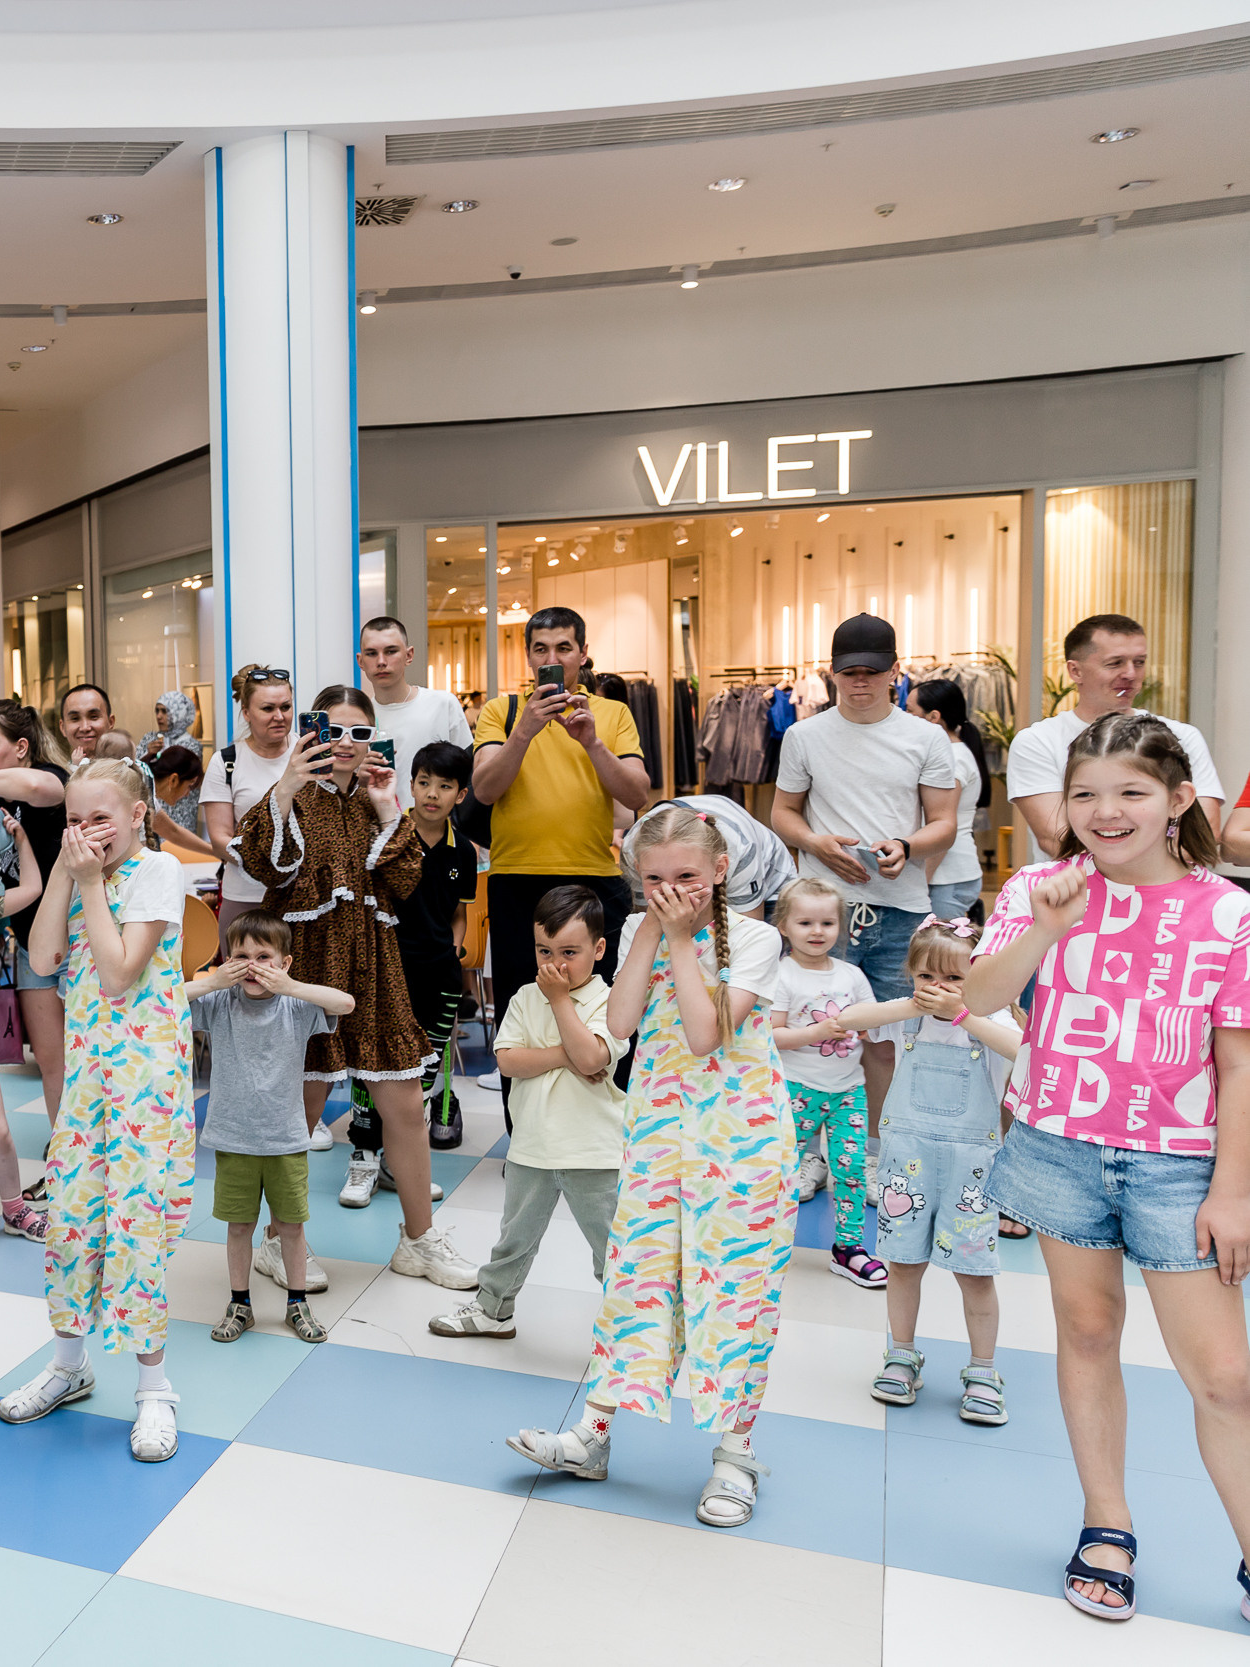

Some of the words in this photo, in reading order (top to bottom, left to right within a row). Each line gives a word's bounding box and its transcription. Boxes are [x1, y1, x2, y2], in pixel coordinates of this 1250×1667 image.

[637, 429, 873, 506] VILET
[1155, 899, 1184, 945] FILA
[1145, 953, 1173, 1000] FILA
[1037, 1063, 1061, 1109] FILA
[1127, 1084, 1151, 1131] FILA
